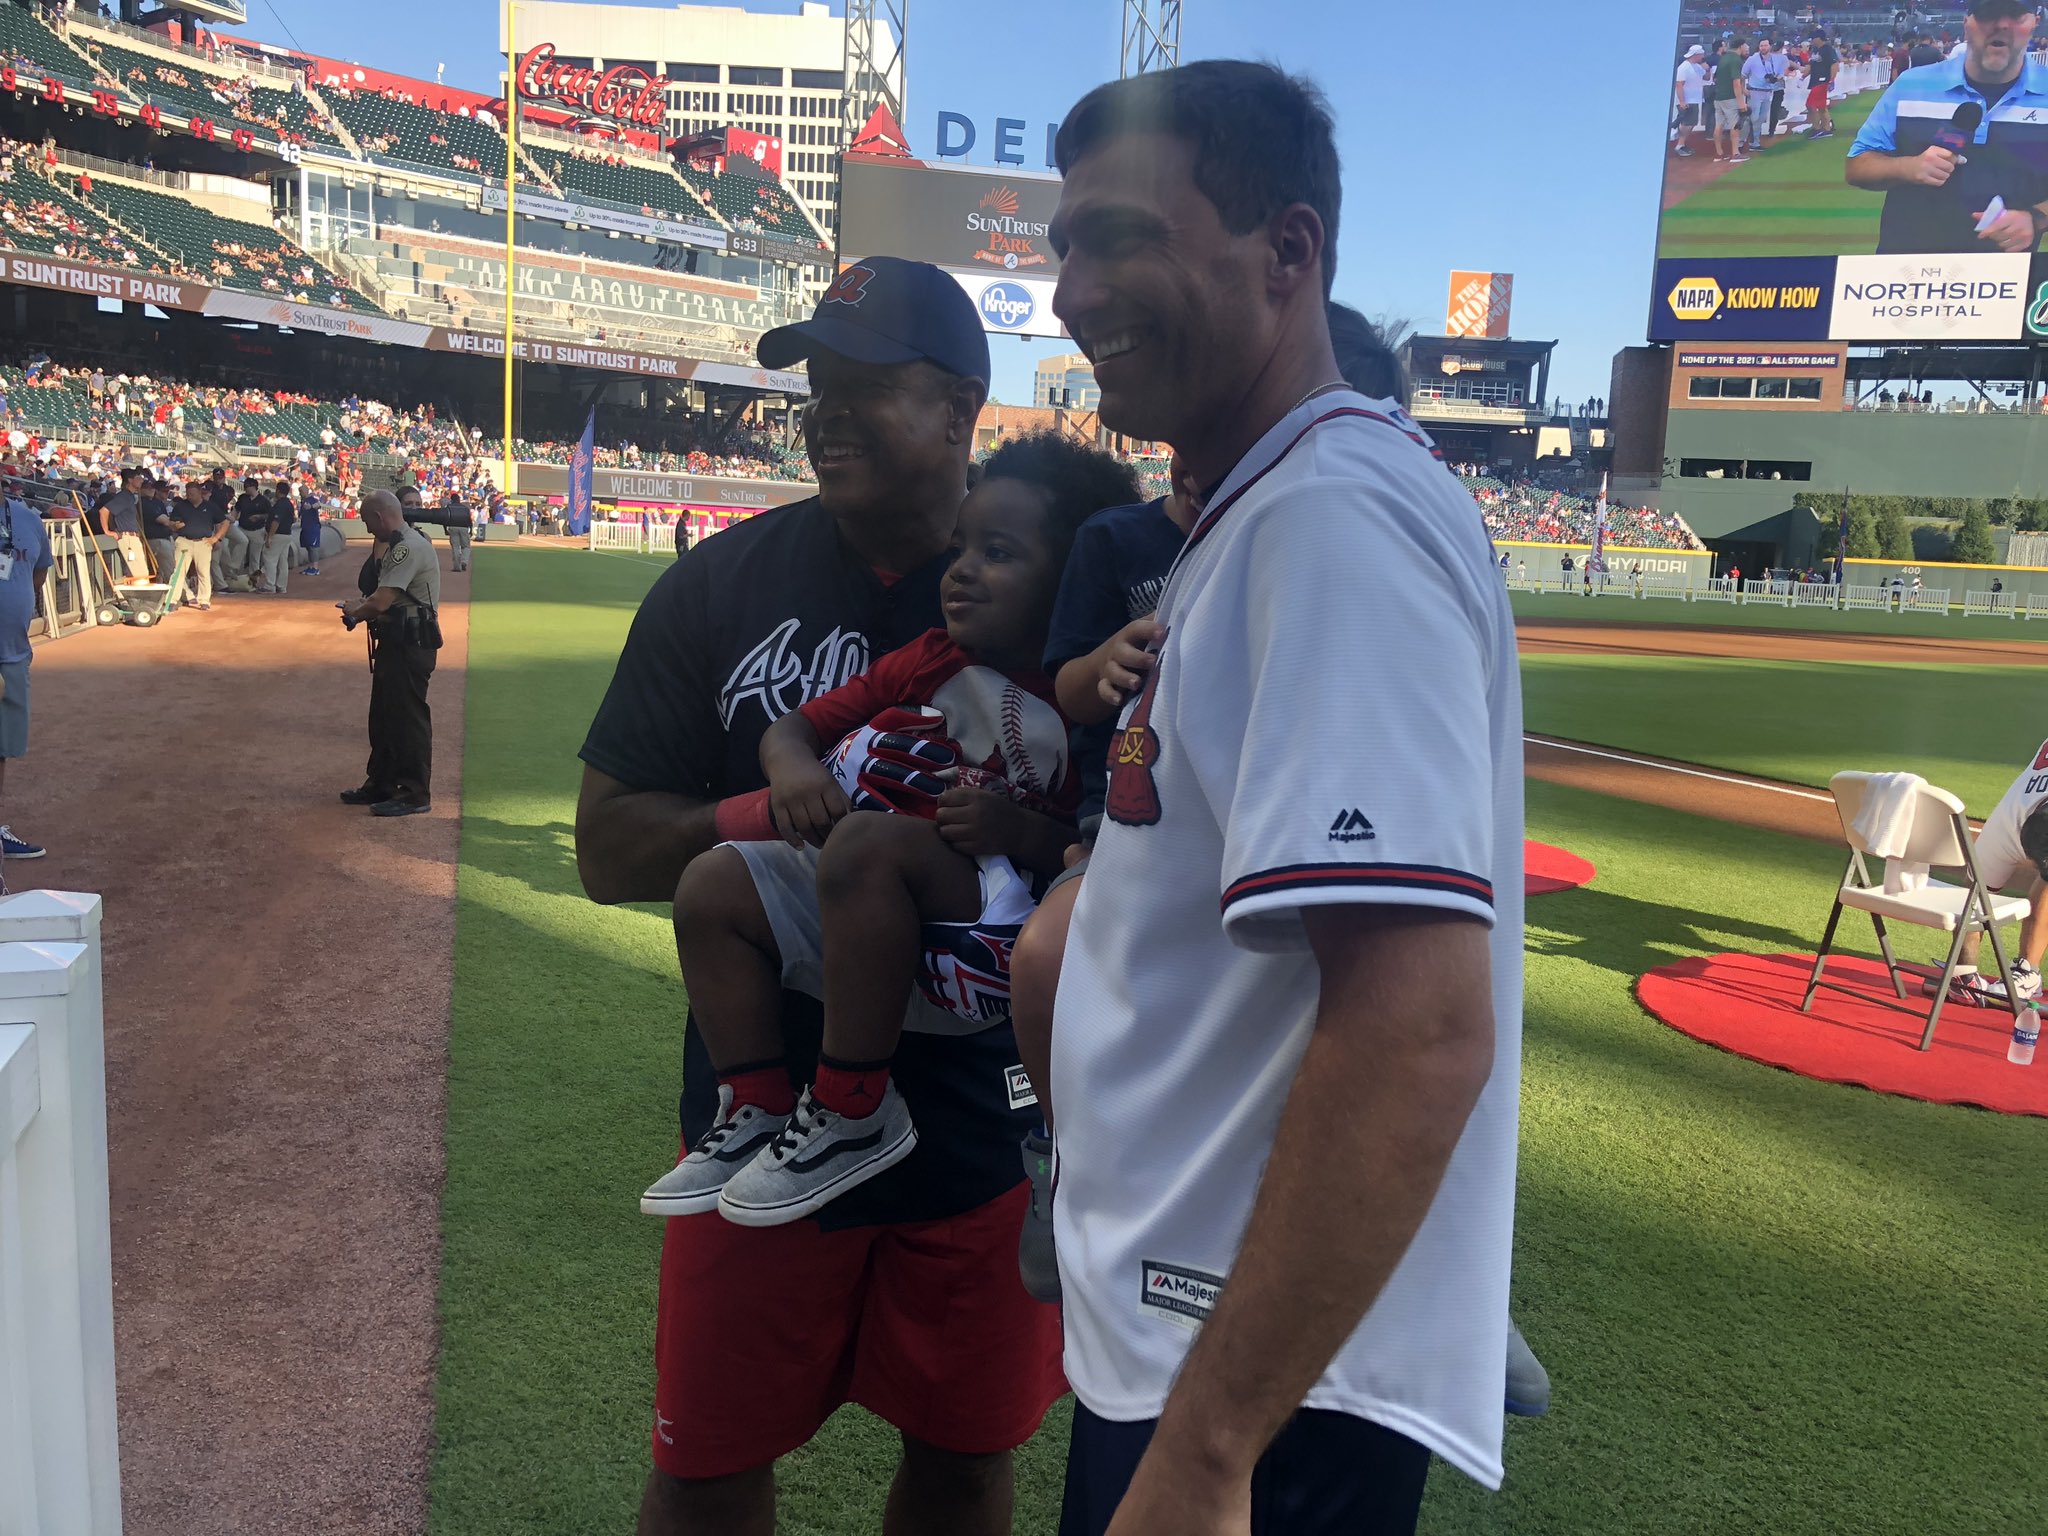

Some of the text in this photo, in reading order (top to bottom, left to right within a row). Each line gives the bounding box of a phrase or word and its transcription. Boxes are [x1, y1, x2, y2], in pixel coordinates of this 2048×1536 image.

[42, 76, 65, 103] 31
[91, 90, 119, 117] 35
[139, 103, 162, 128] 41
[188, 116, 215, 142] 44
[231, 128, 255, 151] 47
[278, 140, 301, 164] 42
[733, 237, 757, 252] 6:33
[988, 232, 1033, 253] PARK
[12, 259, 124, 296] SUNTRUST
[130, 279, 182, 305] PARK
[1455, 279, 1482, 304] THE
[1843, 282, 2018, 300] NORTHSIDE
[984, 287, 1031, 325] Kroger
[1447, 274, 1511, 335] HOME
[1677, 286, 1820, 309] NAPA KNOW HOW
[1471, 299, 1510, 336] DEPOT
[1872, 305, 1982, 317] HOSPITAL
[532, 343, 552, 360] TO
[557, 346, 635, 371] SUNTRUST
[640, 356, 677, 375] PARK
[1682, 356, 1705, 364] HOME
[1706, 356, 1718, 364] OF
[1719, 356, 1734, 364] THE
[1811, 356, 1835, 365] GAME
[610, 475, 693, 499] WELCOME TO
[1608, 557, 1687, 574] HYUNDAI
[1901, 566, 1921, 575] 400
[1175, 1279, 1218, 1303] Majest
[1147, 1295, 1171, 1308] MAJOR
[1173, 1300, 1200, 1316] LEAGUE
